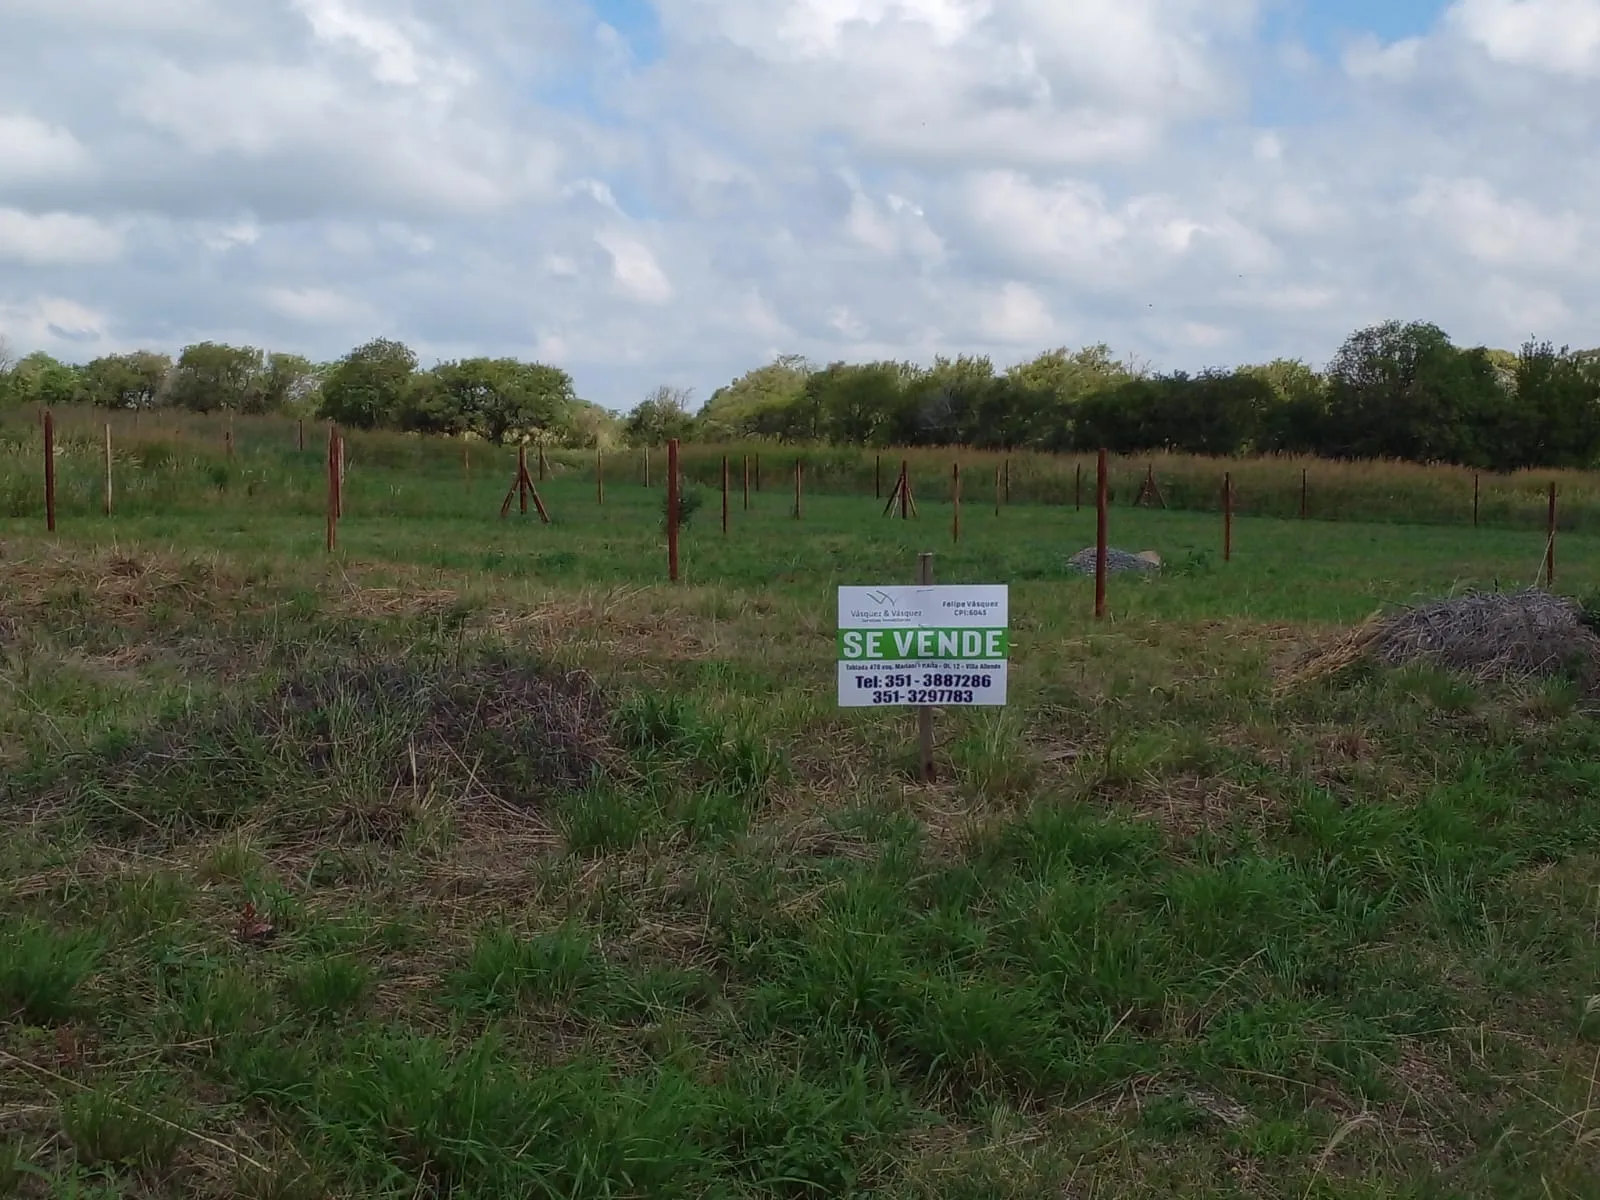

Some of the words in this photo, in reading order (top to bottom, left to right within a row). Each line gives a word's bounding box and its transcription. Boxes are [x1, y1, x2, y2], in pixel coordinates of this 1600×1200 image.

[884, 609, 889, 617] &
[843, 631, 883, 658] SE
[893, 630, 1003, 657] VENDE
[923, 674, 991, 688] 3887286
[908, 690, 974, 704] 3297783
